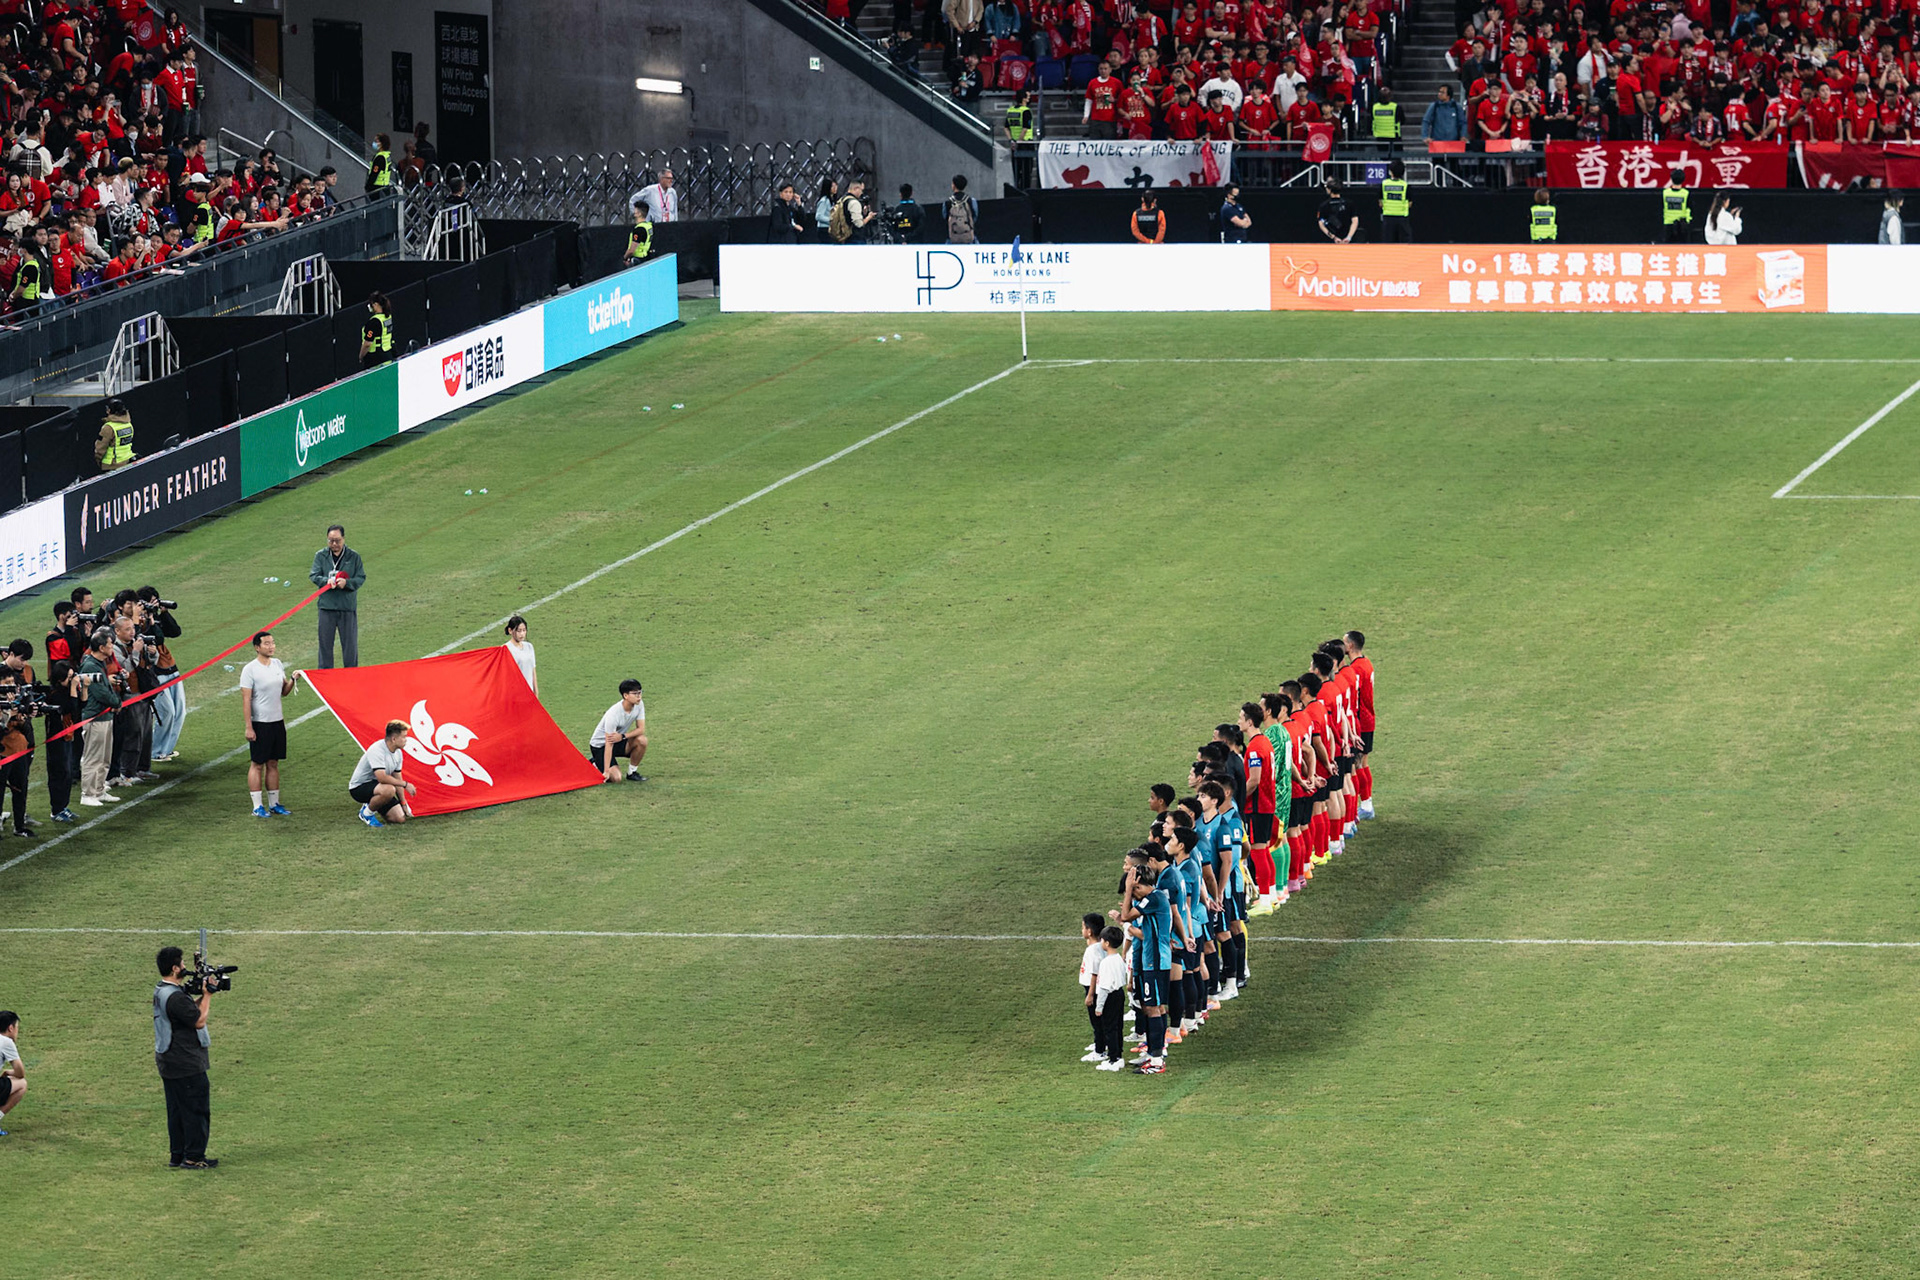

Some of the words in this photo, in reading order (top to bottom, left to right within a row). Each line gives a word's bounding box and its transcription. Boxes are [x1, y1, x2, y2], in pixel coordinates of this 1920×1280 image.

[441, 67, 453, 79] NW
[455, 68, 474, 81] Pitch
[442, 83, 461, 95] Pitch
[462, 85, 488, 99] Access
[442, 99, 475, 116] Vomitory
[1049, 142, 1071, 156] THE
[1077, 142, 1122, 157] POWER
[1128, 144, 1145, 157] OF
[1151, 142, 1187, 157] HONG
[1192, 141, 1227, 156] KNG
[1367, 168, 1385, 179] 216
[1575, 145, 1752, 189] 香港力量
[975, 251, 996, 264] THE
[1002, 251, 1034, 264] PRK
[1040, 251, 1071, 264] LANE
[993, 269, 1020, 277] HONG
[1026, 269, 1051, 277] KONG
[1298, 275, 1381, 297] Mobility
[587, 286, 634, 334] ticketflap
[465, 335, 504, 391] 日清食品
[94, 483, 160, 533] THUNDER
[167, 456, 227, 504] FEATHER
[1144, 982, 1151, 996] 8
